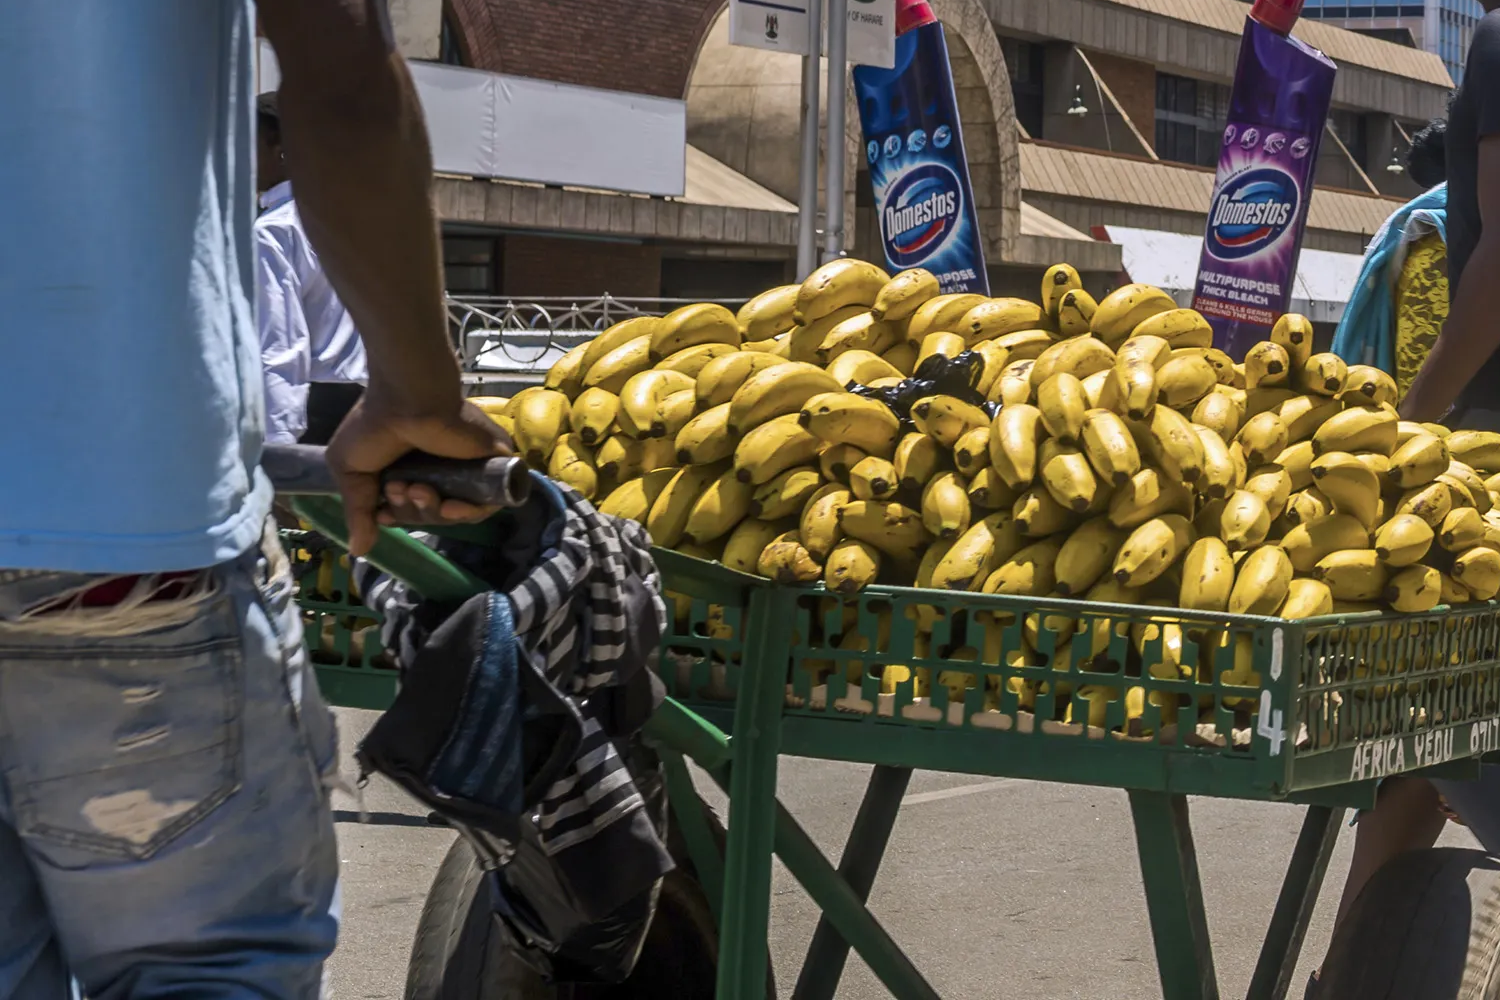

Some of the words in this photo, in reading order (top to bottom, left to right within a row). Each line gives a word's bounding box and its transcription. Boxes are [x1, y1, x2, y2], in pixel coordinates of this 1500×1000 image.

[885, 190, 956, 242] Domestos
[1212, 193, 1291, 227] Domestos
[1198, 270, 1281, 296] MULTIPURPOSE
[1202, 285, 1227, 299] THICK
[1227, 290, 1269, 306] BLEACH
[1204, 306, 1232, 317] AROUND
[1232, 310, 1247, 319] THE
[1247, 315, 1273, 325] HOUSE
[1225, 303, 1246, 313] KILLS
[1246, 308, 1273, 318] GERMS
[1350, 737, 1405, 781] AFRICA
[1414, 727, 1454, 767] YEDU
